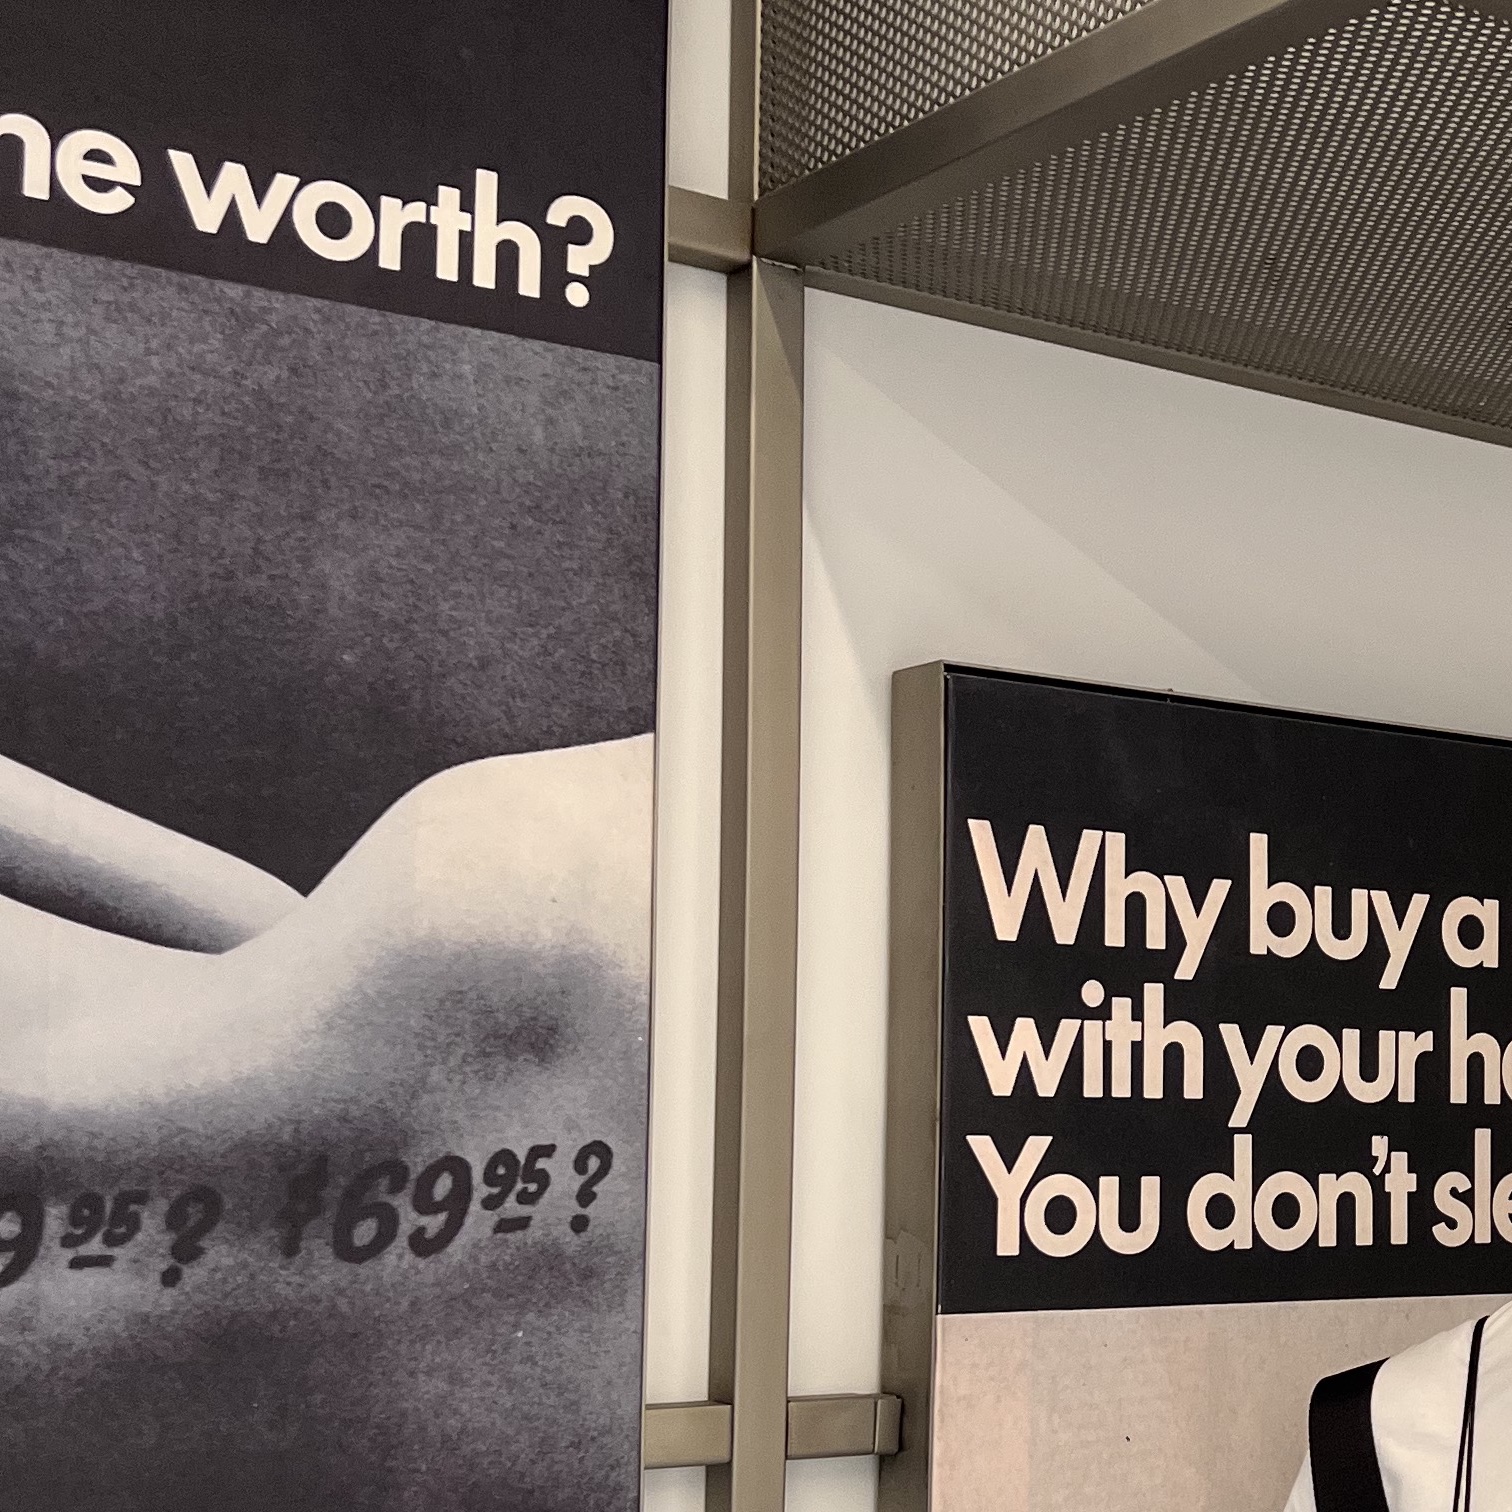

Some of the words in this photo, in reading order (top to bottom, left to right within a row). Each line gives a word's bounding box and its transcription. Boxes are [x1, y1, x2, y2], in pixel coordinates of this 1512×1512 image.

[167, 148, 614, 308] worth?
[967, 818, 1230, 981] Why
[1249, 832, 1430, 989] buy
[1441, 898, 1499, 969] a
[967, 979, 1204, 1100] with
[1220, 1021, 1433, 1128] your
[965, 1133, 1160, 1258] You
[1187, 1133, 1419, 1252] don't
